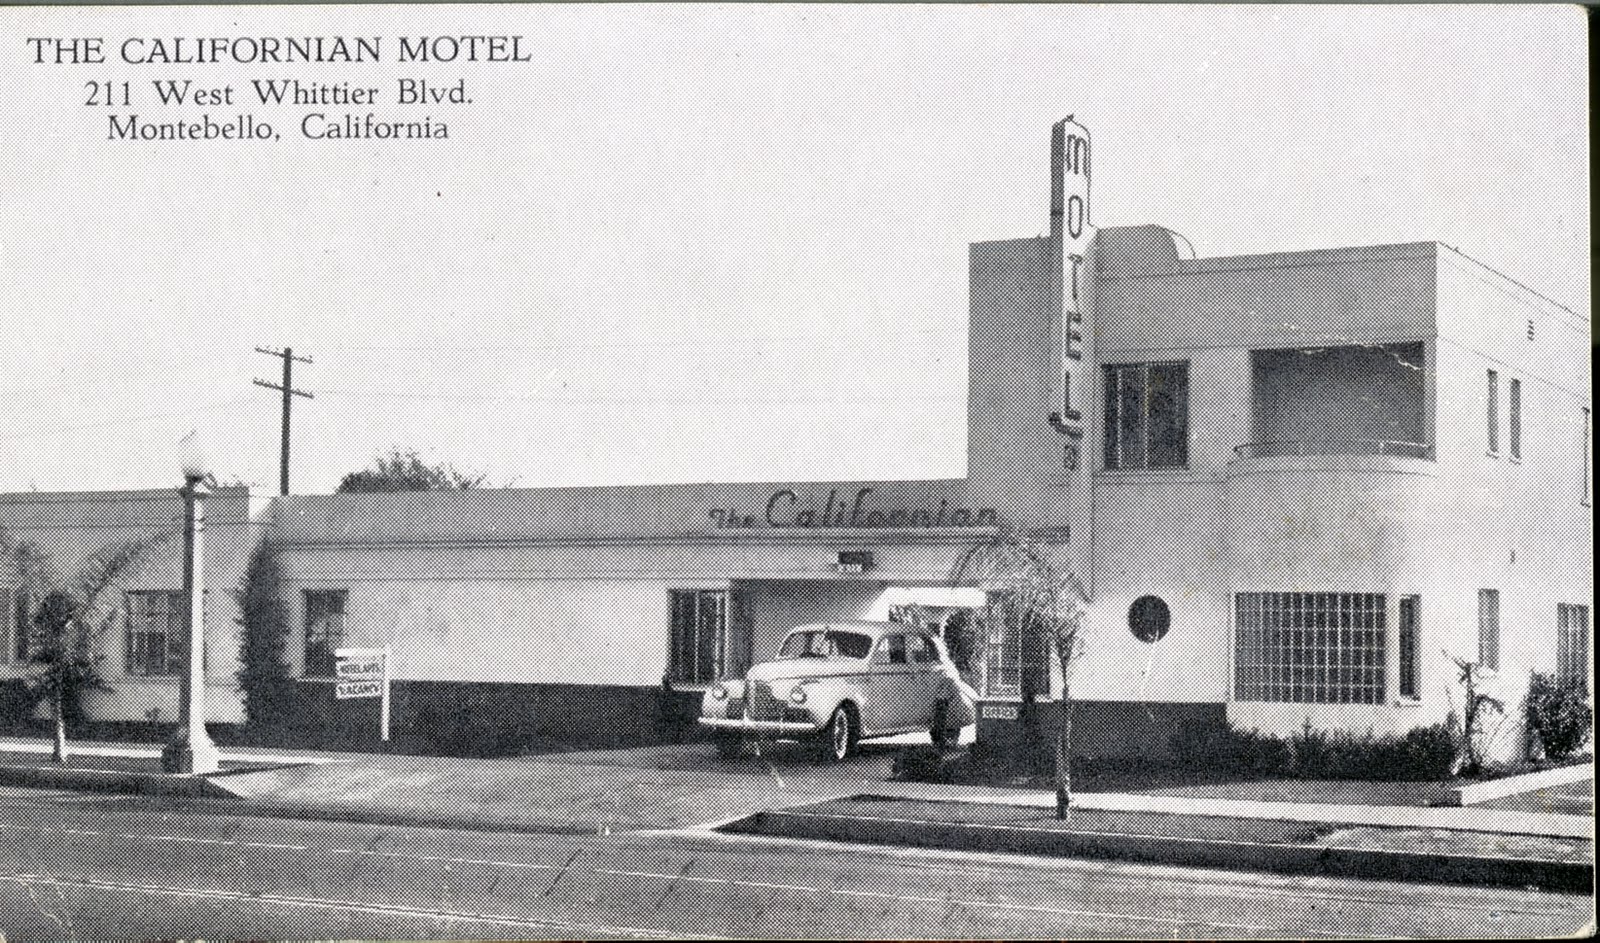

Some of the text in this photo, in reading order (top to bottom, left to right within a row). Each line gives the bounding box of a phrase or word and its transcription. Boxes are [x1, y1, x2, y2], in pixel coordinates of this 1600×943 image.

[1065, 133, 1089, 422] MOTEL
[709, 487, 998, 529] The Californian
